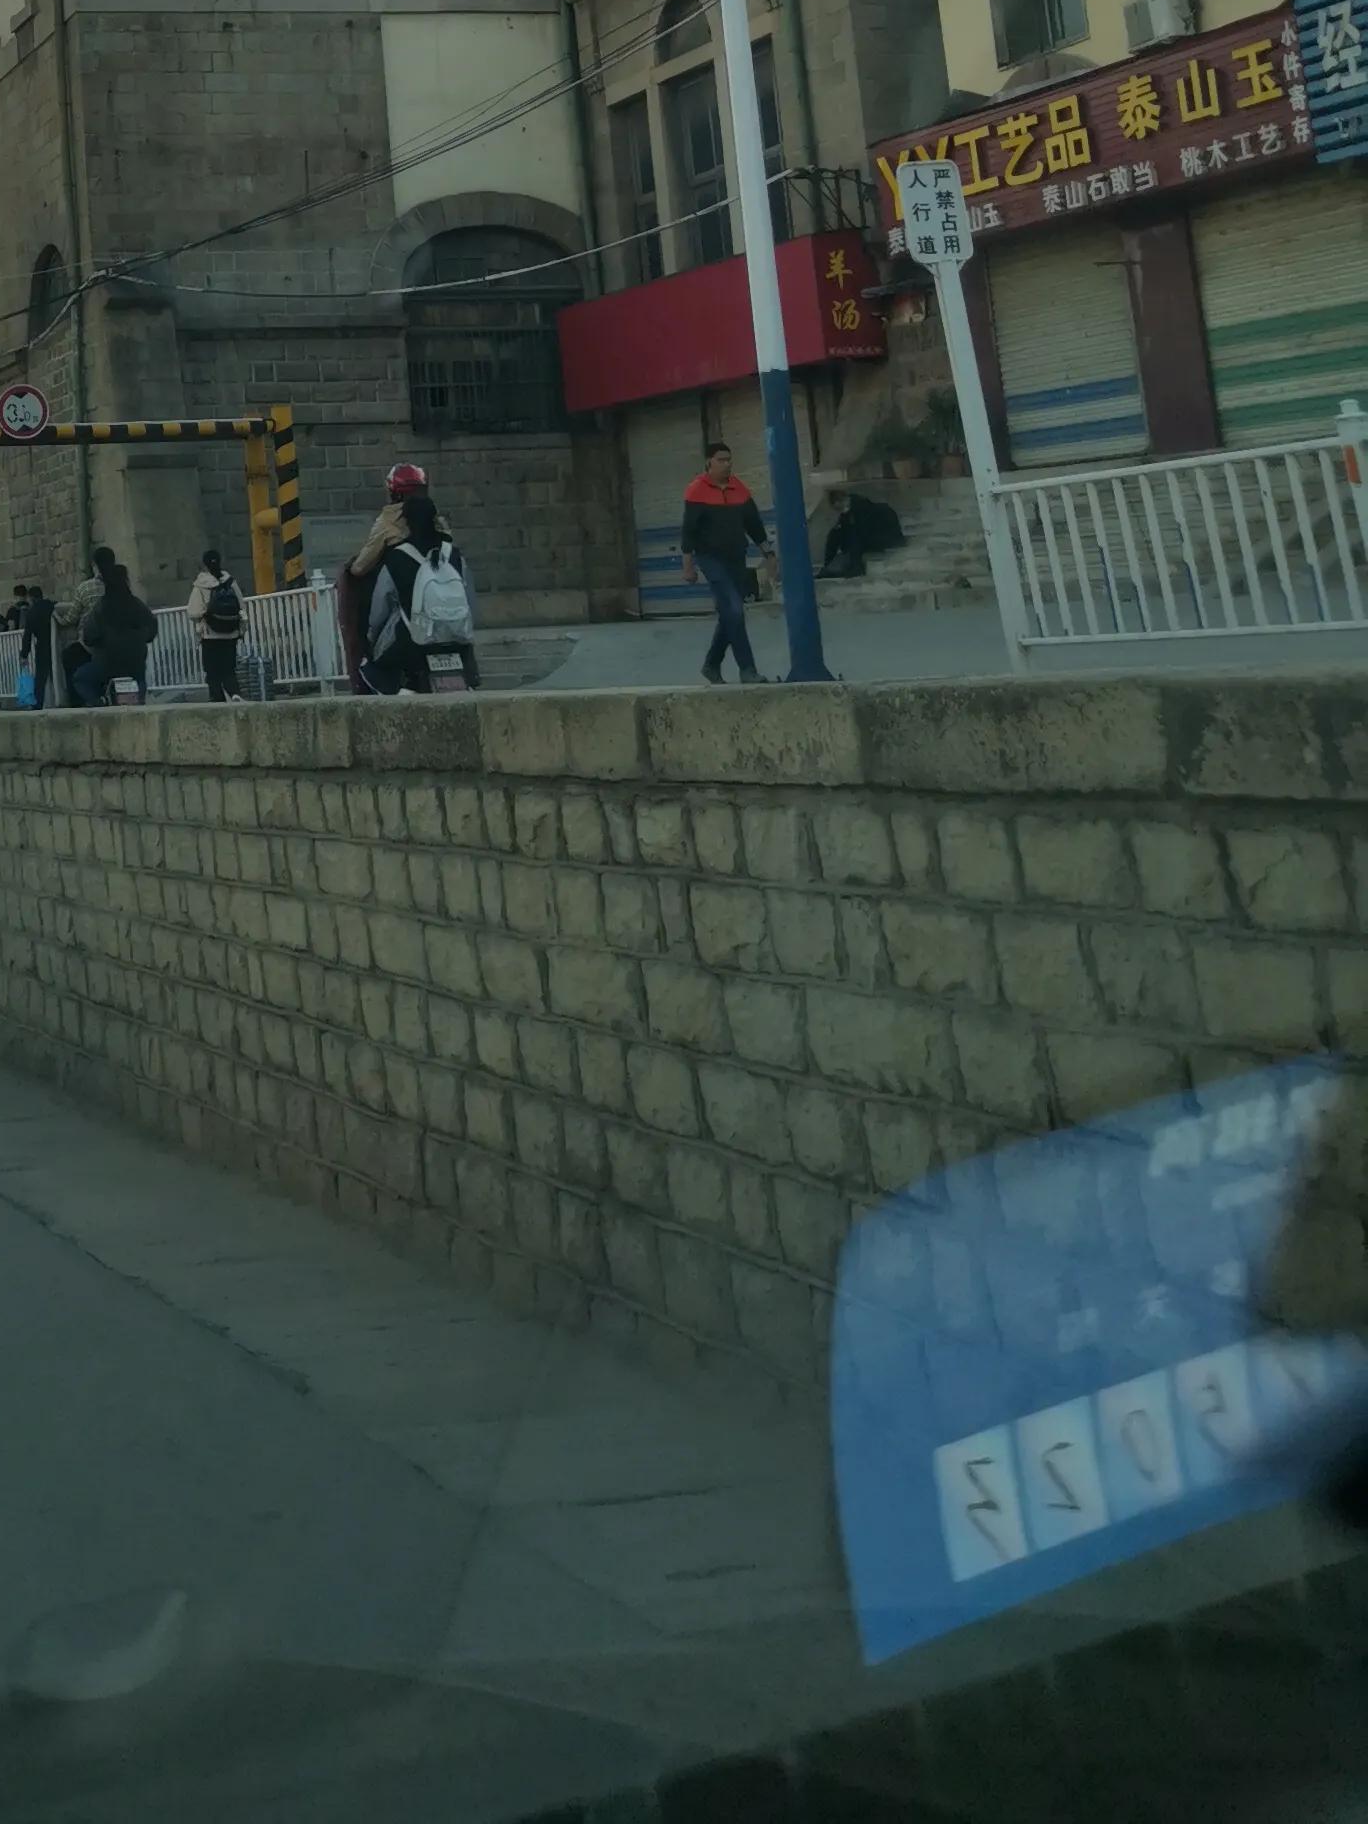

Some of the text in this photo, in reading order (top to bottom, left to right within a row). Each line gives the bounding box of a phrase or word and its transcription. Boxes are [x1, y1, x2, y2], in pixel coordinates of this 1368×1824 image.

[1115, 37, 1284, 141] 泰山玉
[1279, 19, 1312, 145] 小件寄存
[907, 169, 937, 255] 人行道
[932, 167, 962, 255] 严禁占用
[1041, 160, 1158, 214] 泰山石敢当
[1179, 124, 1285, 179] 桃木工艺
[824, 247, 862, 332] 羊汤
